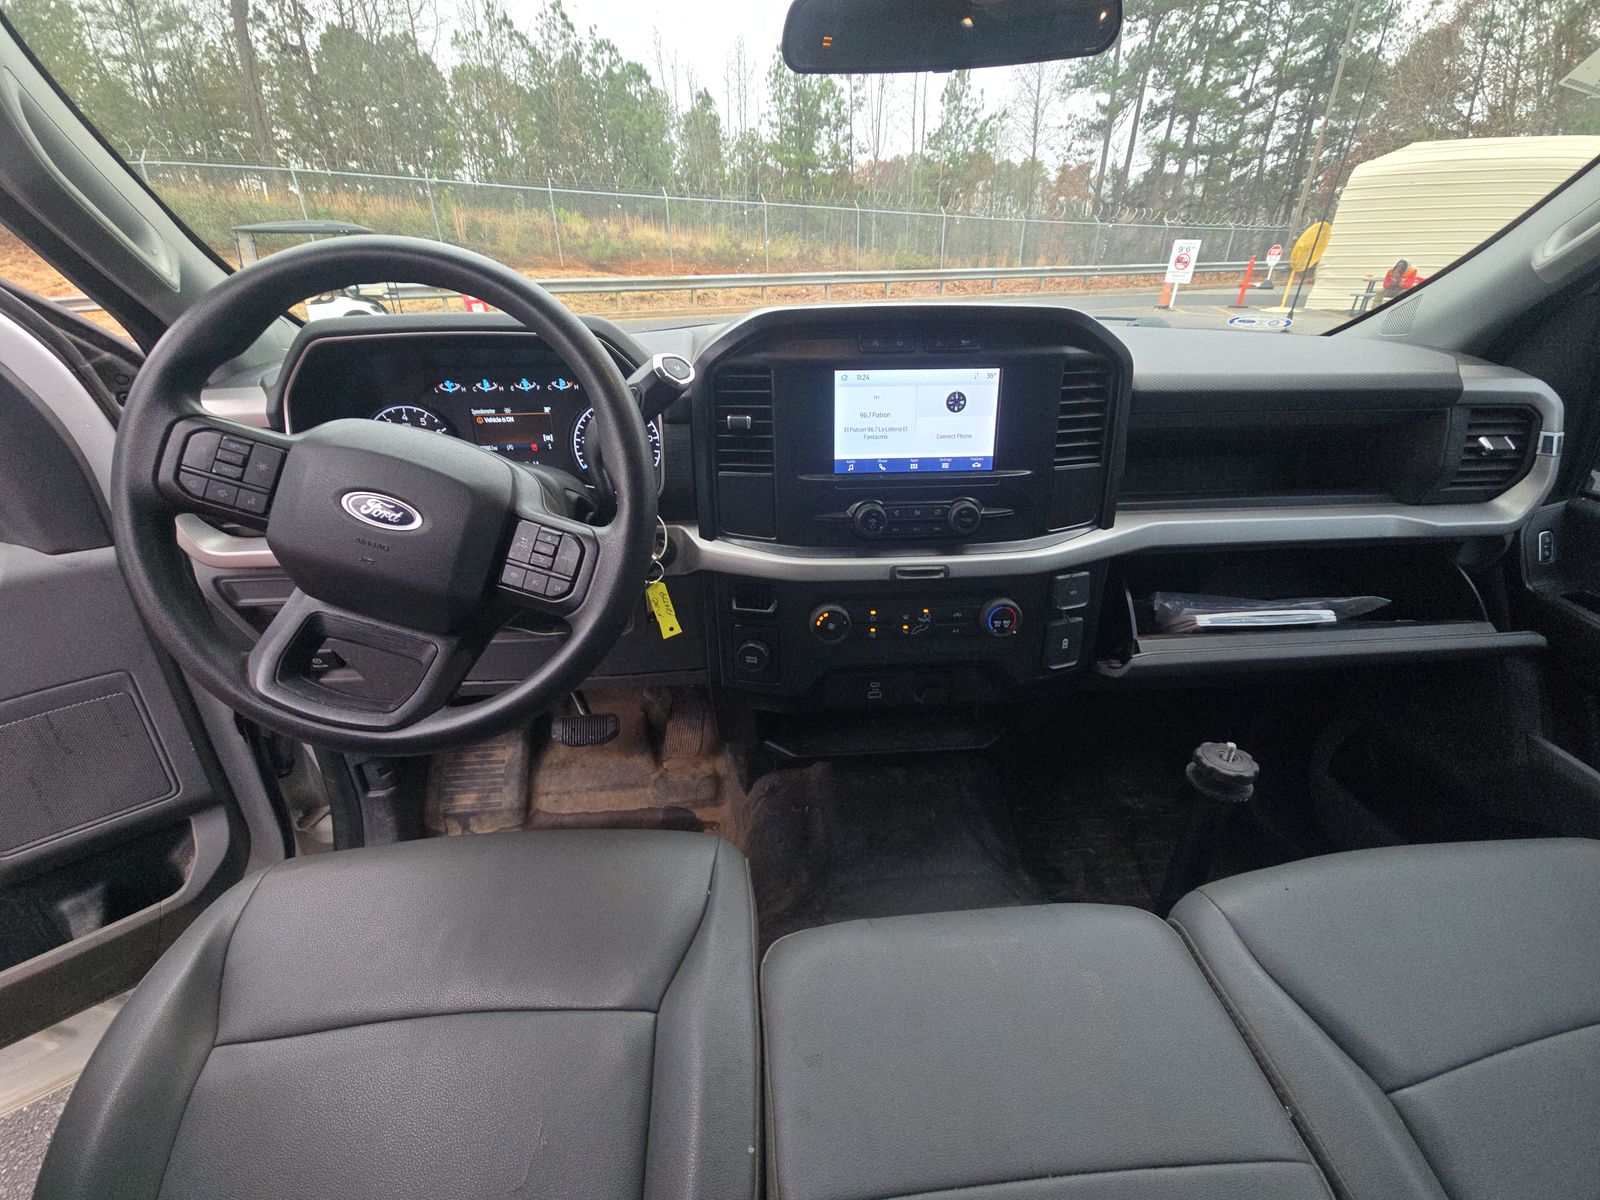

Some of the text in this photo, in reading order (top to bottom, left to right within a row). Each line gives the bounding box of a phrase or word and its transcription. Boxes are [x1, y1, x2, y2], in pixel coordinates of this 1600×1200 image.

[402, 413, 408, 421] 4
[420, 418, 427, 426] 5
[360, 499, 404, 523] Ford
